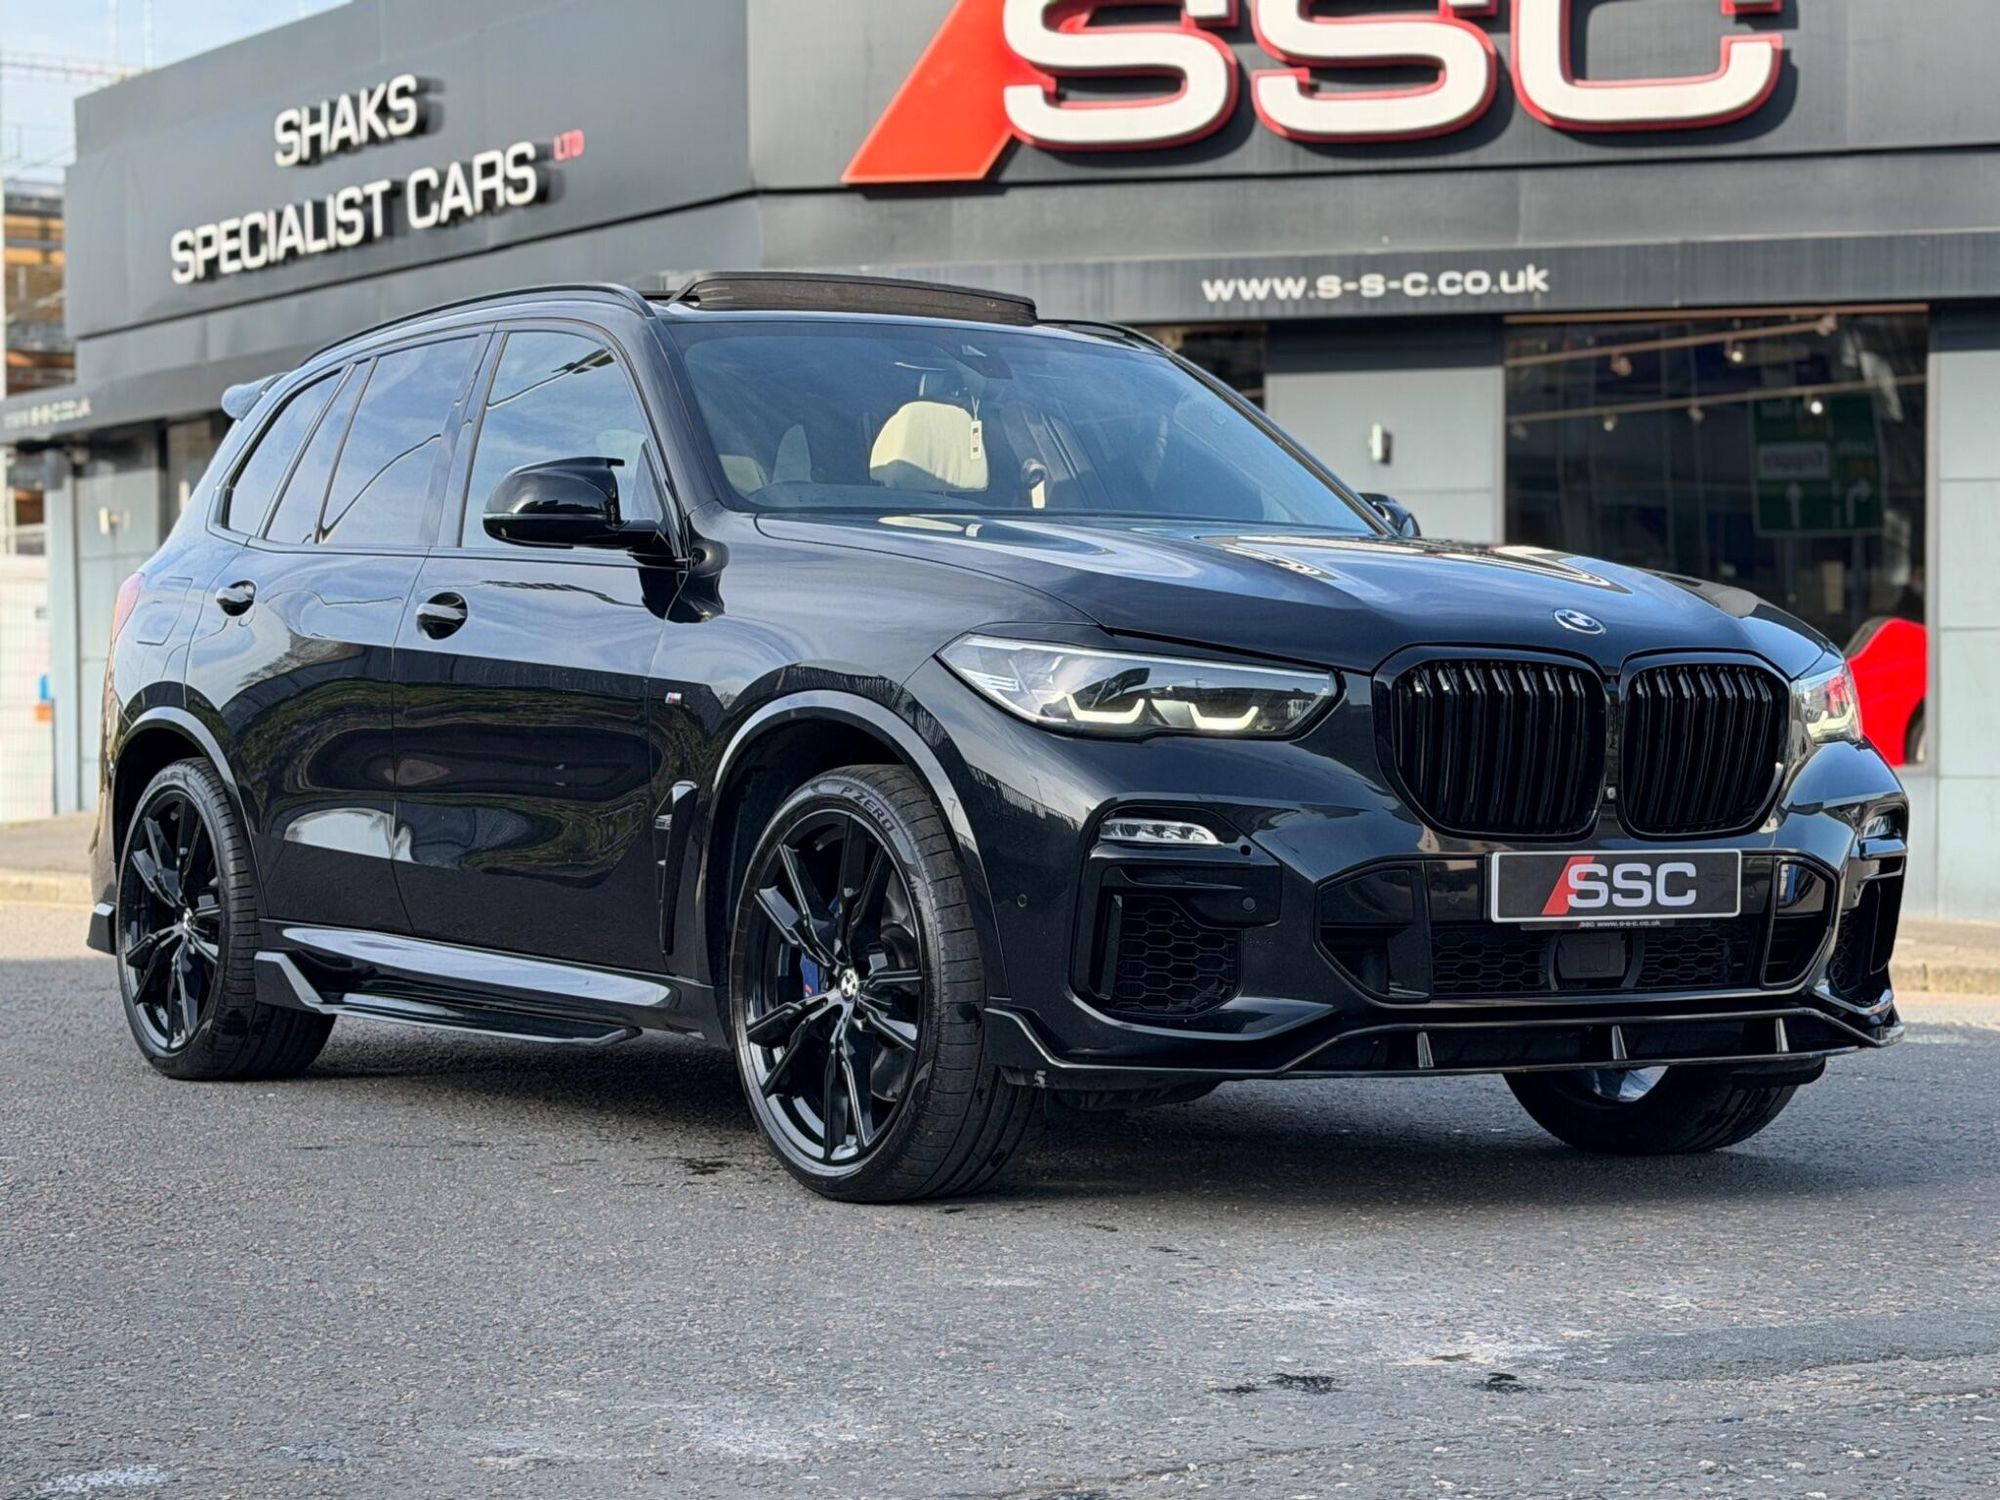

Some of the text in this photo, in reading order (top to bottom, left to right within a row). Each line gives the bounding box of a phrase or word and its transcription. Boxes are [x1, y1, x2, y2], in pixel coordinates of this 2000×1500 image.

[1004, 0, 1782, 151] SSC
[275, 74, 418, 166] SHAKS
[172, 129, 585, 284] SPECIALIST CARS LTD
[1202, 264, 1549, 302] www.s-s-c.co.uk
[840, 786, 896, 831] P ZERO
[1567, 862, 1696, 908] SSC
